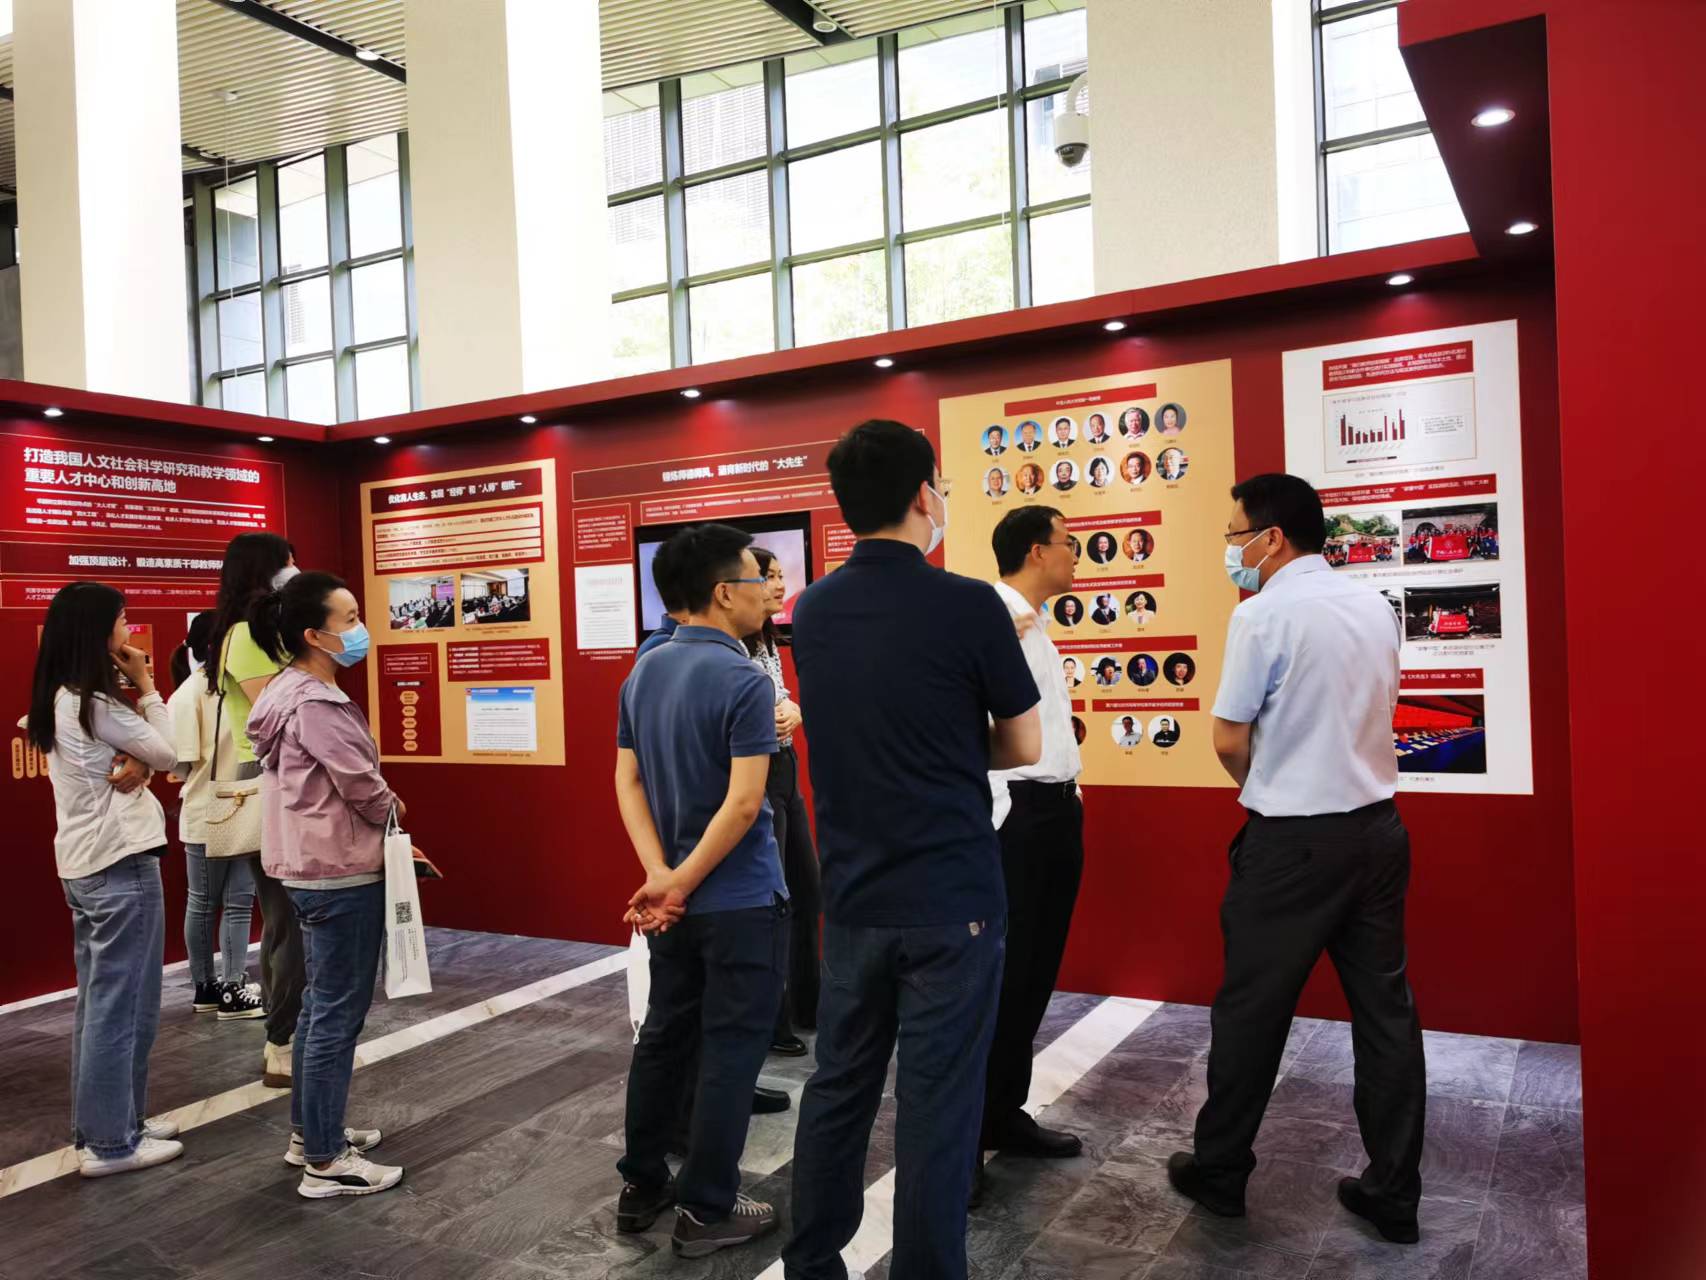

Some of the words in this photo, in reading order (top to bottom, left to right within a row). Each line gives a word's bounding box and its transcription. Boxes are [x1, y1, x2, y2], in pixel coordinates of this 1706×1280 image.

[24, 447, 259, 484] 打造我国人文社会科学研究和教学领域的
[25, 468, 177, 493] 重要人才中心和创新高地
